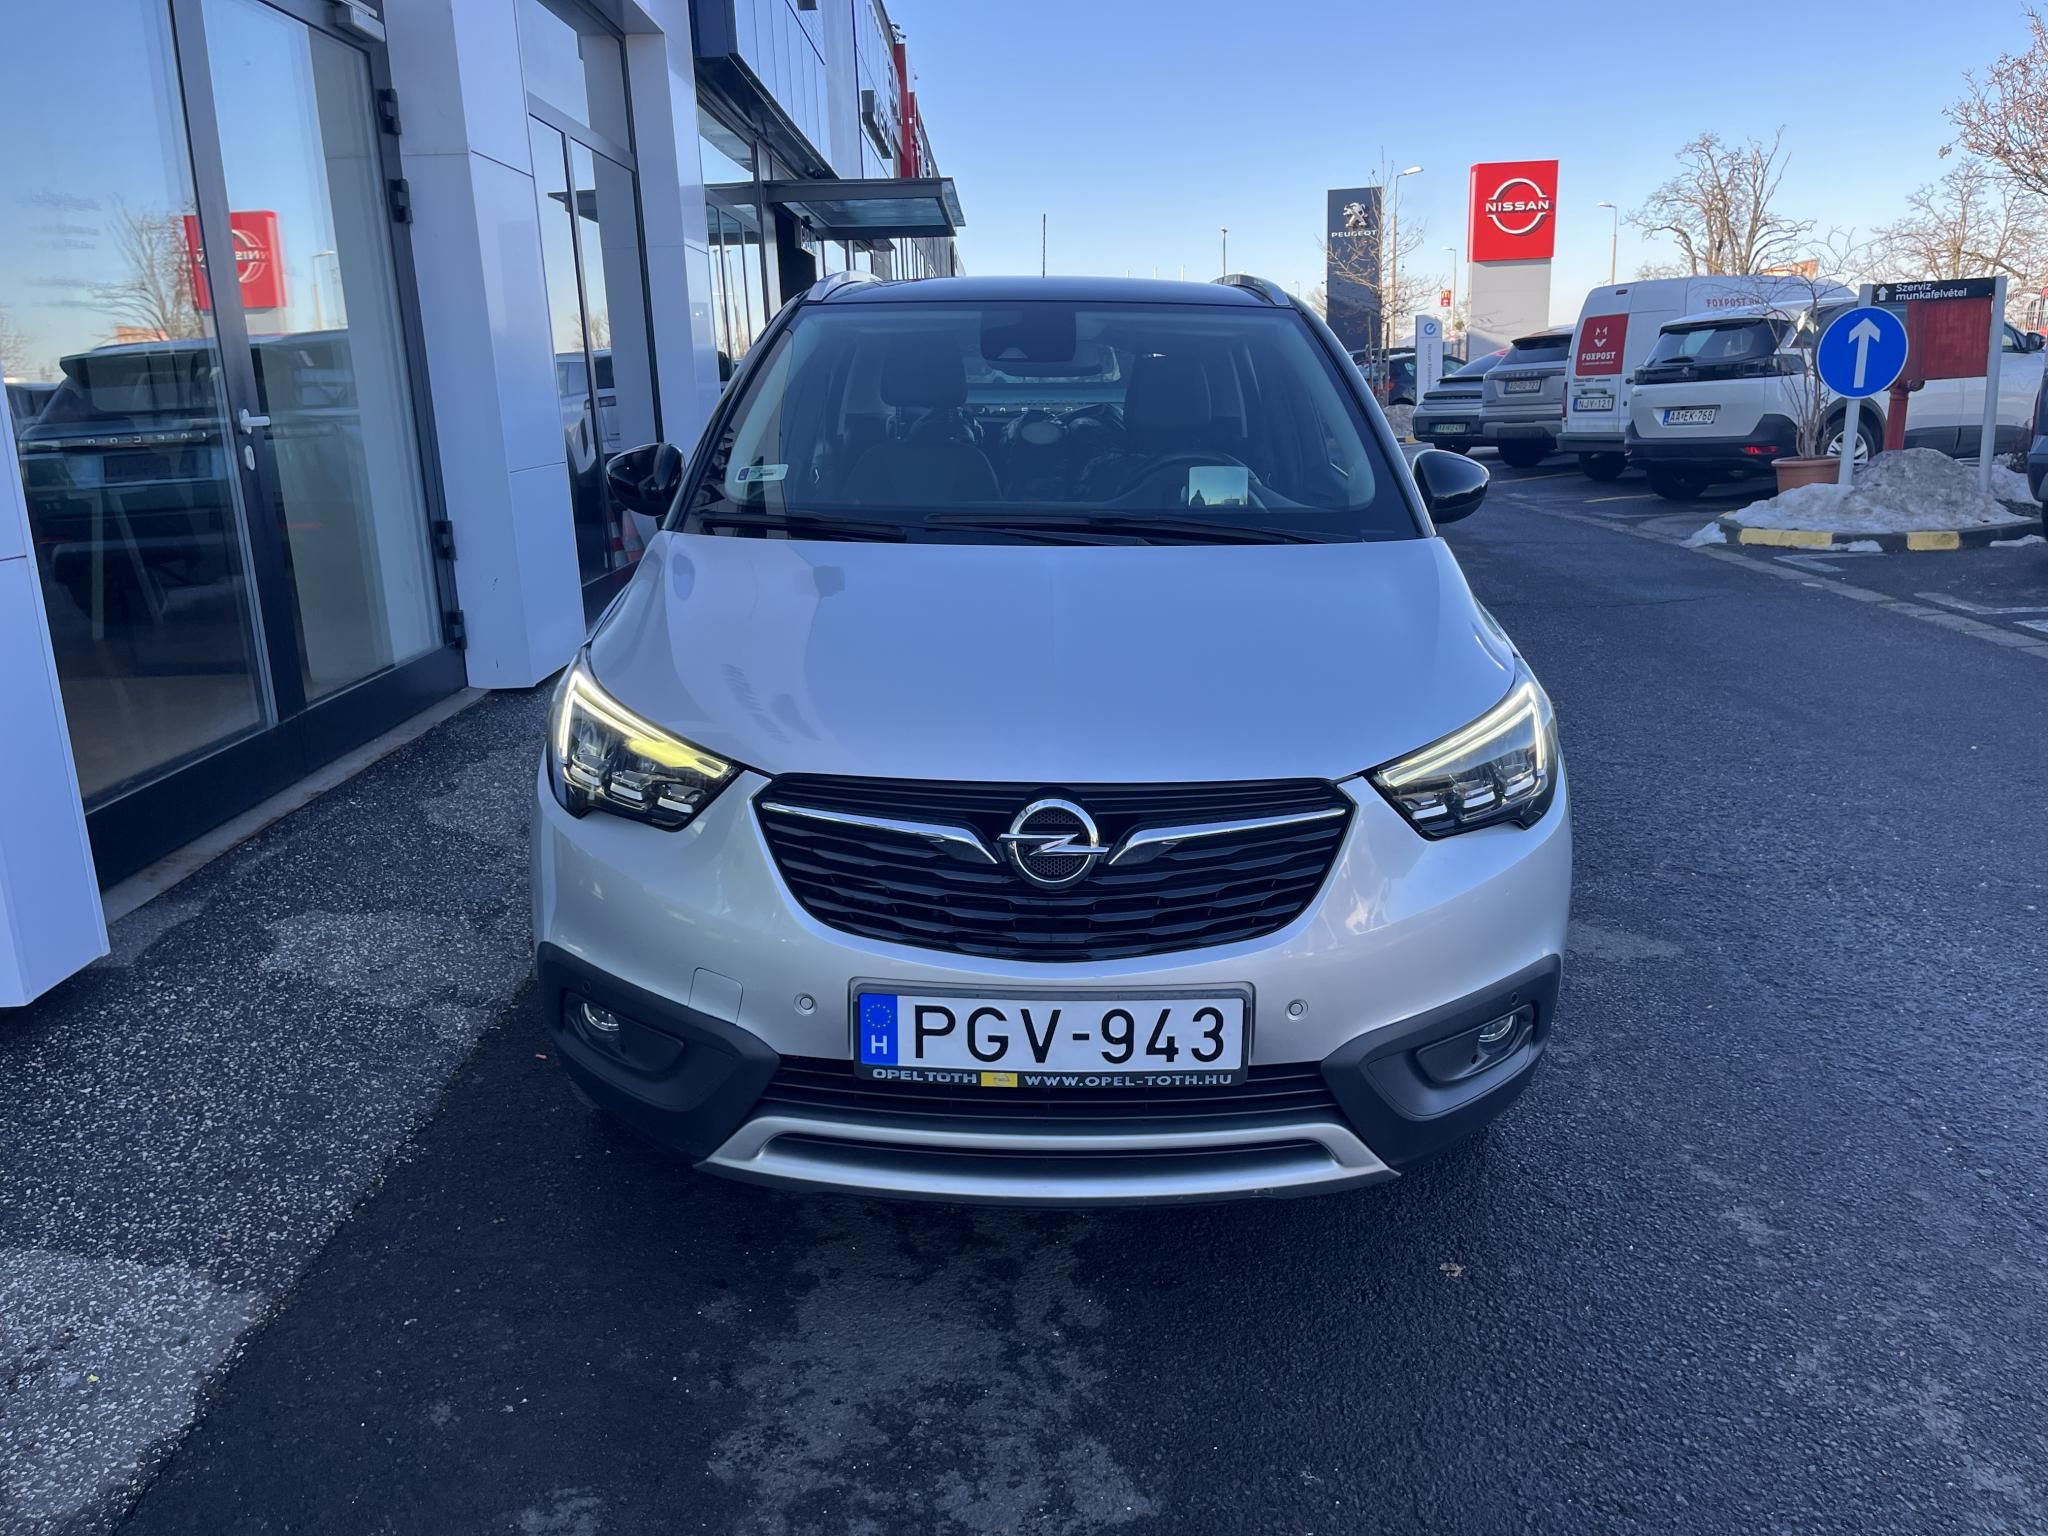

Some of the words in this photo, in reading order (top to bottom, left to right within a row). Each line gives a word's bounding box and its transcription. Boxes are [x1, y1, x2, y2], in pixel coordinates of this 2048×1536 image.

[1485, 199, 1550, 213] NISSAN
[1331, 229, 1377, 238] PEUGEOT
[1895, 283, 1932, 292] Szerviz
[1895, 288, 1967, 300] munkafelvétel
[1581, 351, 1616, 361] FOXPOST
[914, 1004, 1224, 1064] PGV-943
[871, 1034, 888, 1055] H
[872, 1068, 924, 1081] OPEL
[924, 1071, 977, 1084] TOTH
[1024, 1073, 1232, 1087] WWW.OPEL-TOTH.HU
